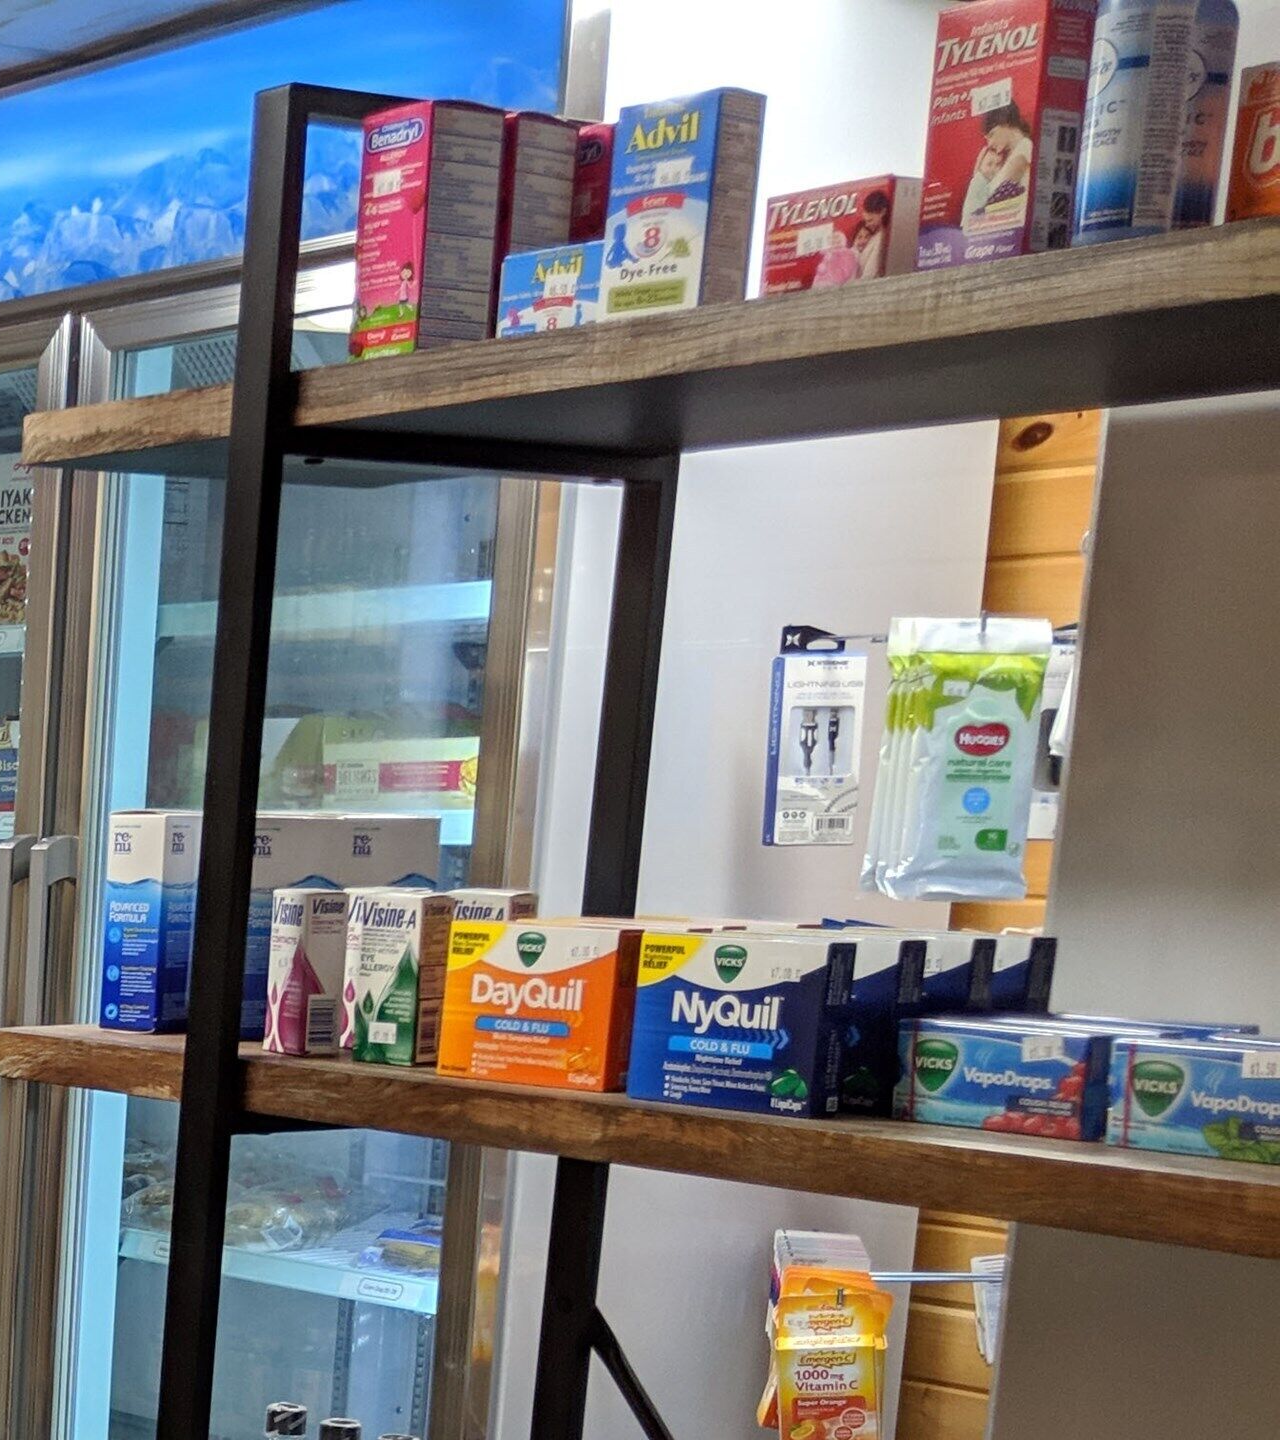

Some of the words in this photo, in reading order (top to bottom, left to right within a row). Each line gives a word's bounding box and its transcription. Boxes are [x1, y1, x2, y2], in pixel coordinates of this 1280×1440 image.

[938, 24, 1038, 71] TYLENOL
[933, 92, 959, 110] Pain
[370, 124, 422, 149] Benadryl
[625, 111, 699, 154] Advil
[768, 194, 858, 229] TYLENOL
[643, 227, 661, 248] 8
[965, 242, 995, 259] Grape
[620, 262, 678, 282] Dye-Free
[787, 680, 842, 690] LIGHTNING
[843, 680, 864, 688] USB
[958, 732, 1006, 746] HUGGIES
[948, 758, 985, 768] natural
[988, 760, 1011, 768] care
[109, 902, 150, 913] ADVANCED
[273, 896, 303, 927] Visine
[312, 898, 345, 916] Visine
[109, 911, 147, 924] FORMULA
[363, 900, 417, 931] Visine-A
[453, 931, 490, 942] POWERFUL
[452, 946, 475, 956] RELIEF
[644, 943, 686, 955] POWERFUL
[360, 952, 375, 963] EYE
[642, 959, 668, 970] RELIEF
[715, 956, 744, 967] VICKS
[360, 962, 394, 973] ALLERGY
[470, 973, 584, 1015] DayQuil
[671, 989, 780, 1034] NyQuil
[494, 1019, 519, 1031] COLD
[531, 1022, 550, 1034] FLU
[690, 1039, 718, 1051] COLD
[721, 1042, 728, 1052] &
[731, 1043, 750, 1055] FLU
[915, 1054, 954, 1071] VICKS
[963, 1066, 1053, 1093] VapoDrops
[1134, 1077, 1179, 1095] VICKS
[829, 1372, 844, 1381] mg
[795, 1382, 848, 1392] Vitamin
[849, 1380, 858, 1390] C
